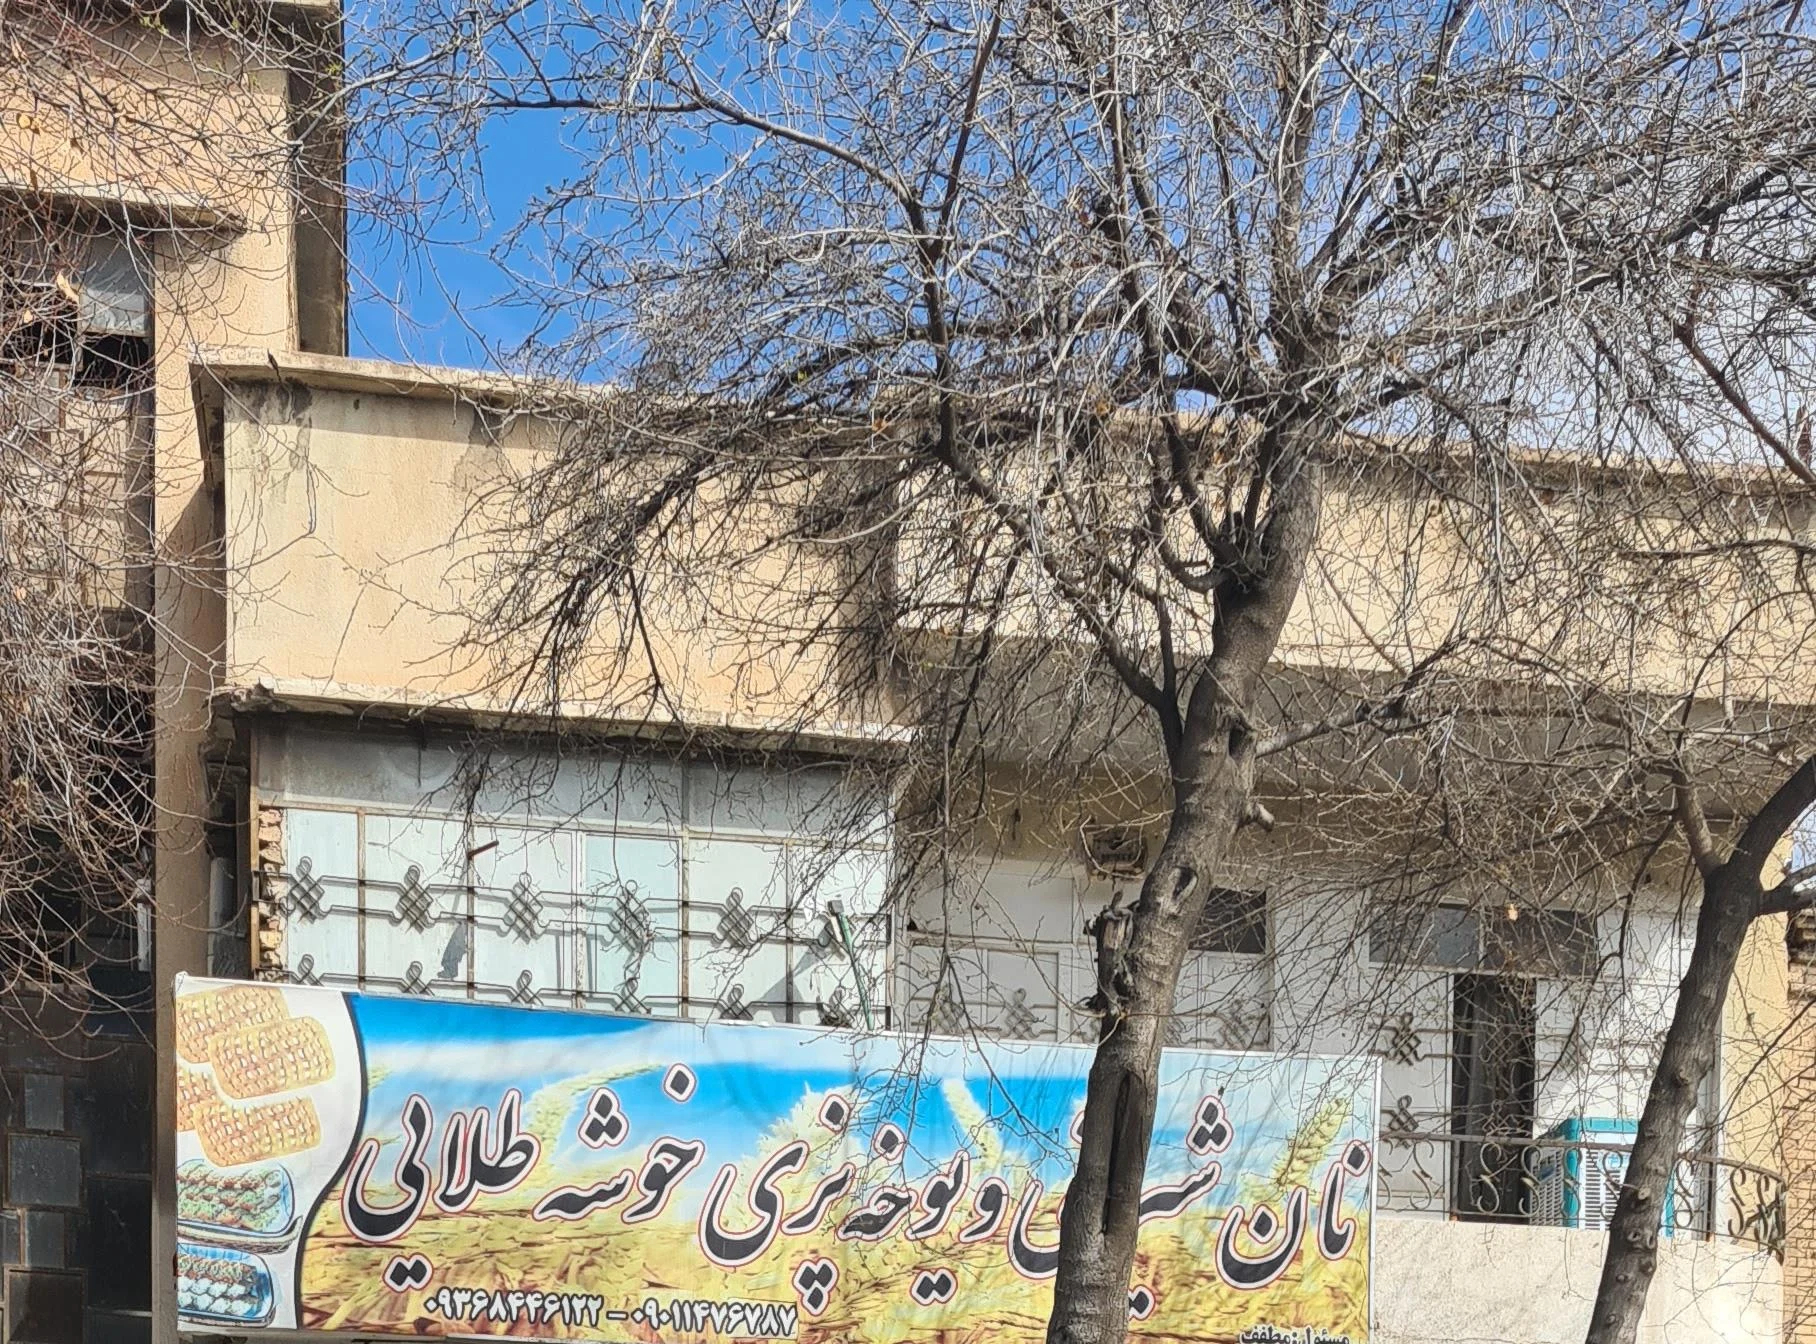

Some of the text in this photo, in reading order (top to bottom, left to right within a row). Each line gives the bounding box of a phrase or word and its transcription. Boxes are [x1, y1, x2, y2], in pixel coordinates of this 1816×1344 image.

[341, 1088, 541, 1292] طلایی
[533, 1063, 705, 1225] خوشه
[699, 1093, 856, 1315] پزی
[1215, 1139, 1371, 1290] نان
[424, 1286, 605, 1327] ۰۹۳۶۸۴۴۶۱۲۲
[631, 1297, 798, 1337] ۰۹۰۱۱۴۷۶۷۸۷
